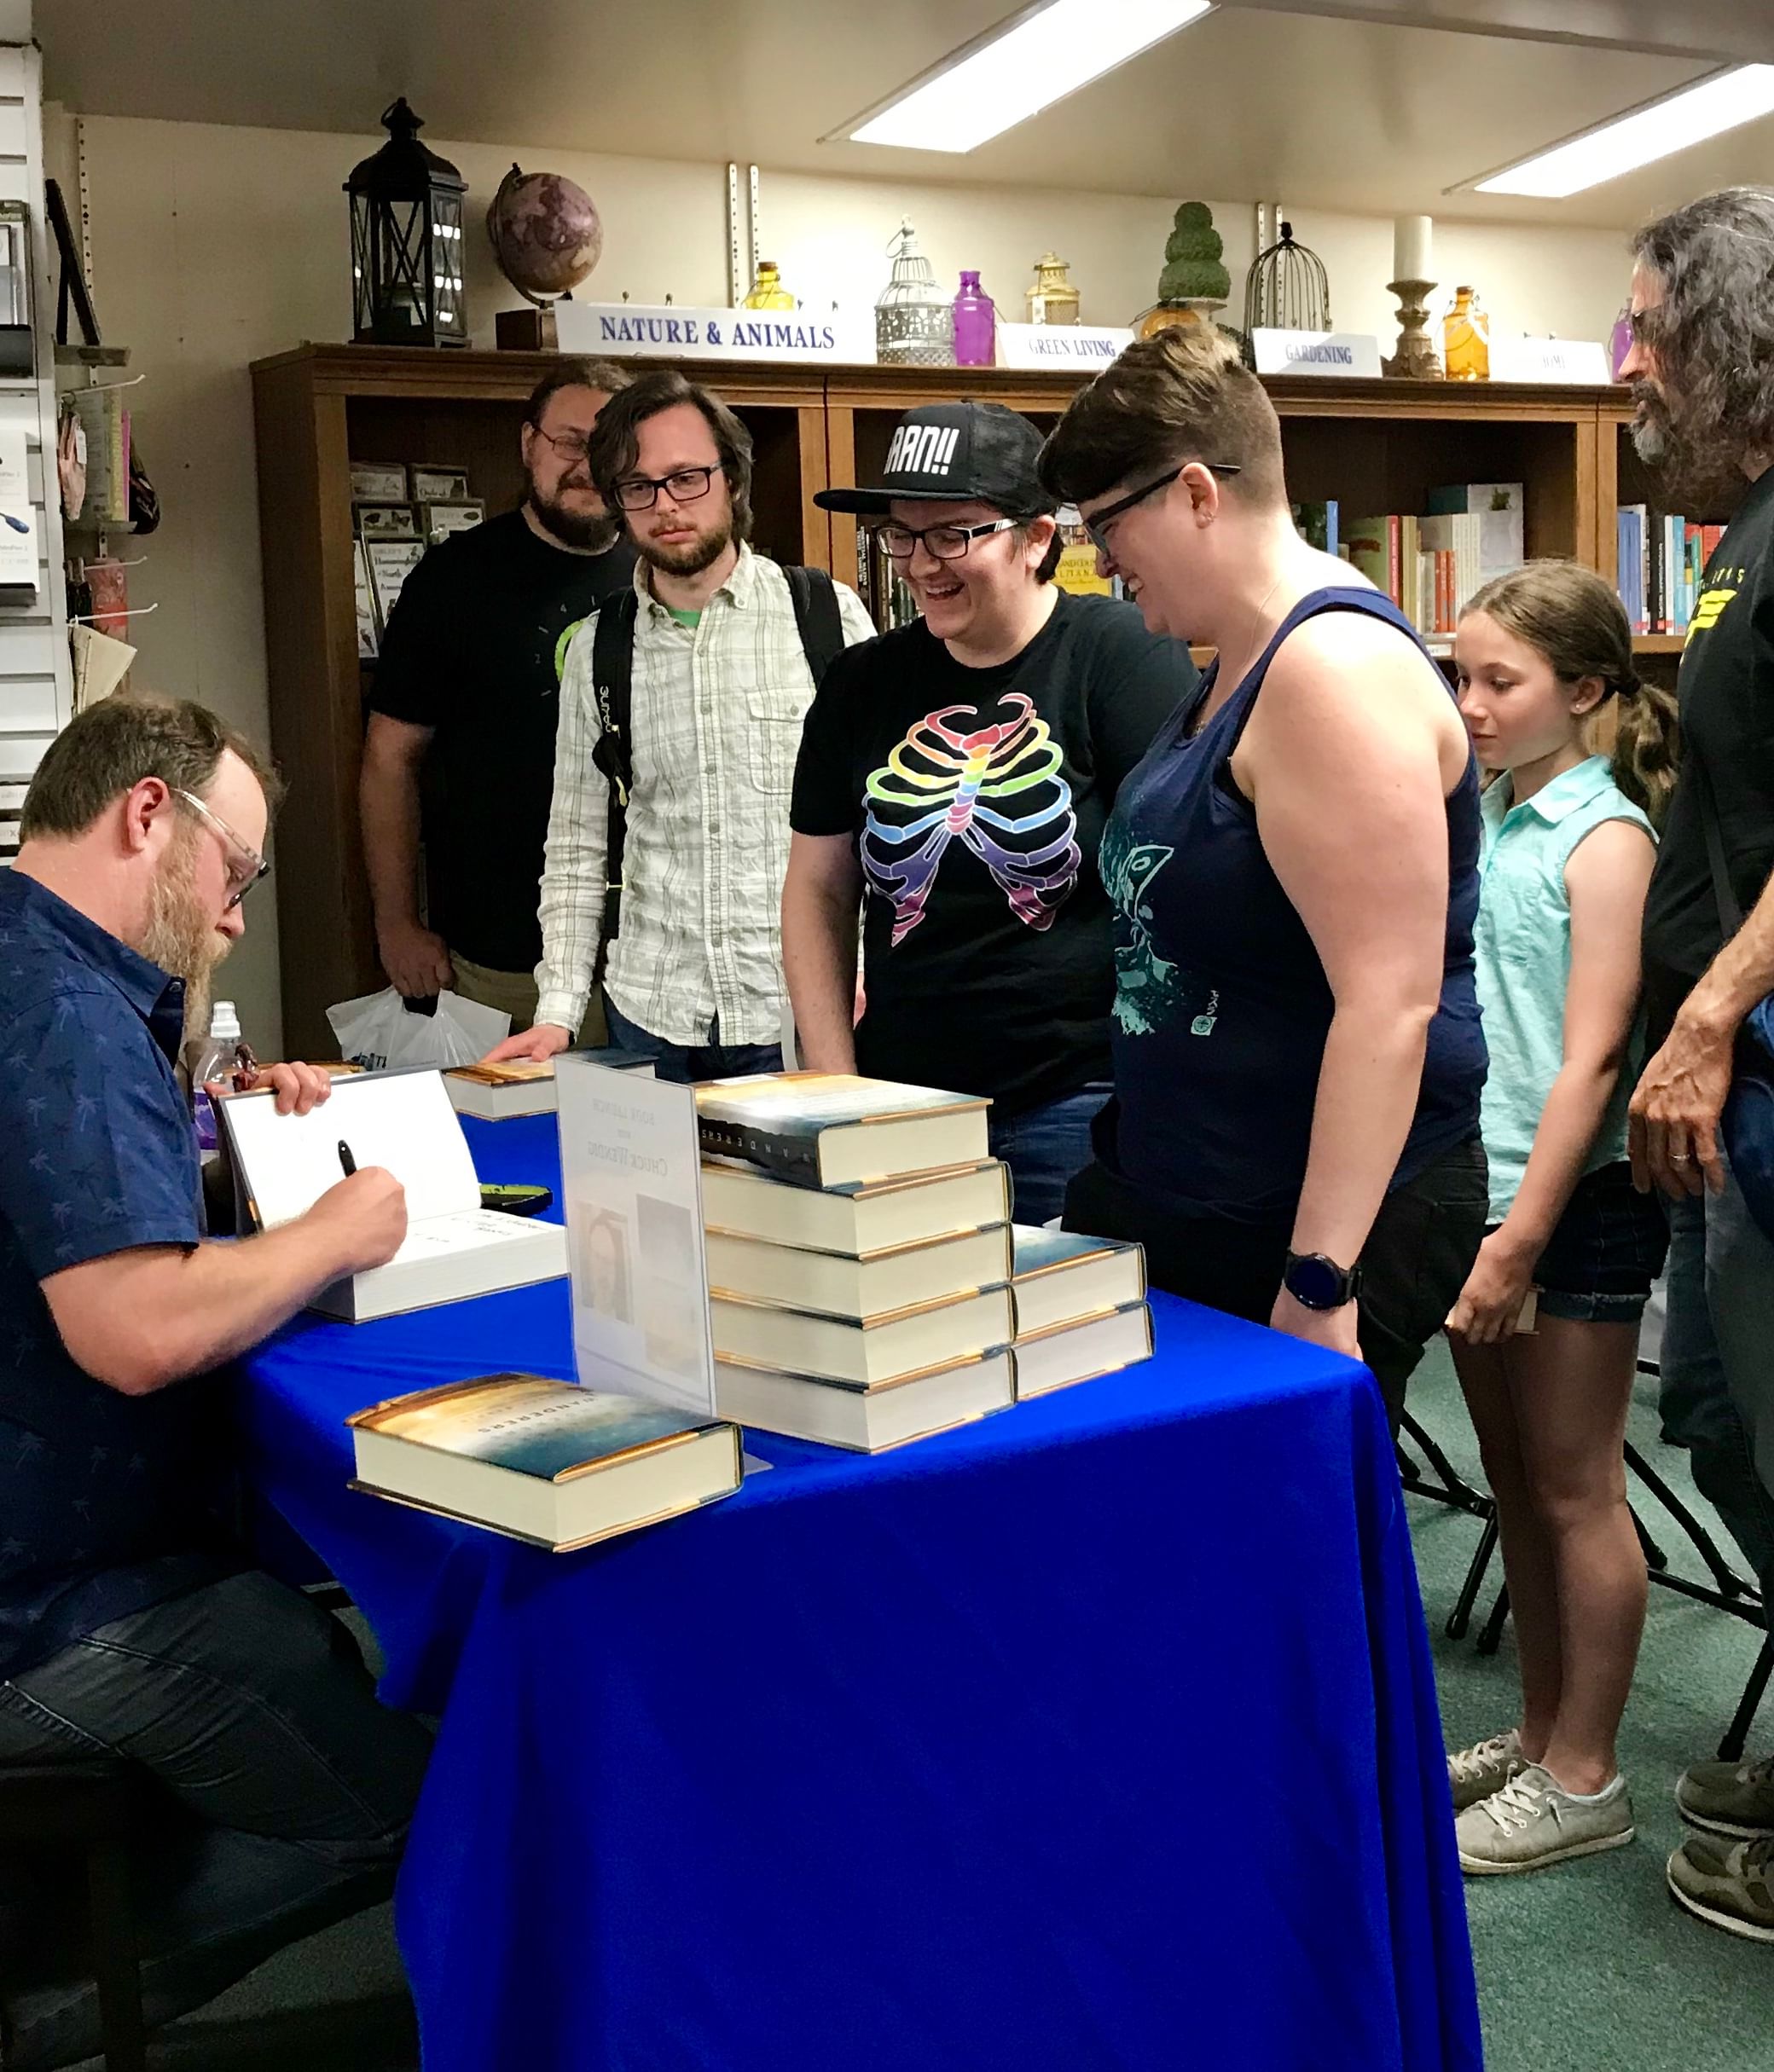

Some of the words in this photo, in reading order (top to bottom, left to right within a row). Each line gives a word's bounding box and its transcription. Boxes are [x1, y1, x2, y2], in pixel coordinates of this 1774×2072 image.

[600, 315, 699, 344] NATURE
[706, 324, 723, 346] &
[732, 323, 836, 350] ANIMALS
[1029, 338, 1071, 356] GREEN
[1074, 339, 1116, 357] LIVING
[1284, 343, 1353, 365] GARDENING
[701, 1129, 811, 1163] WANDERERS
[477, 1395, 596, 1434] WANDERERS
